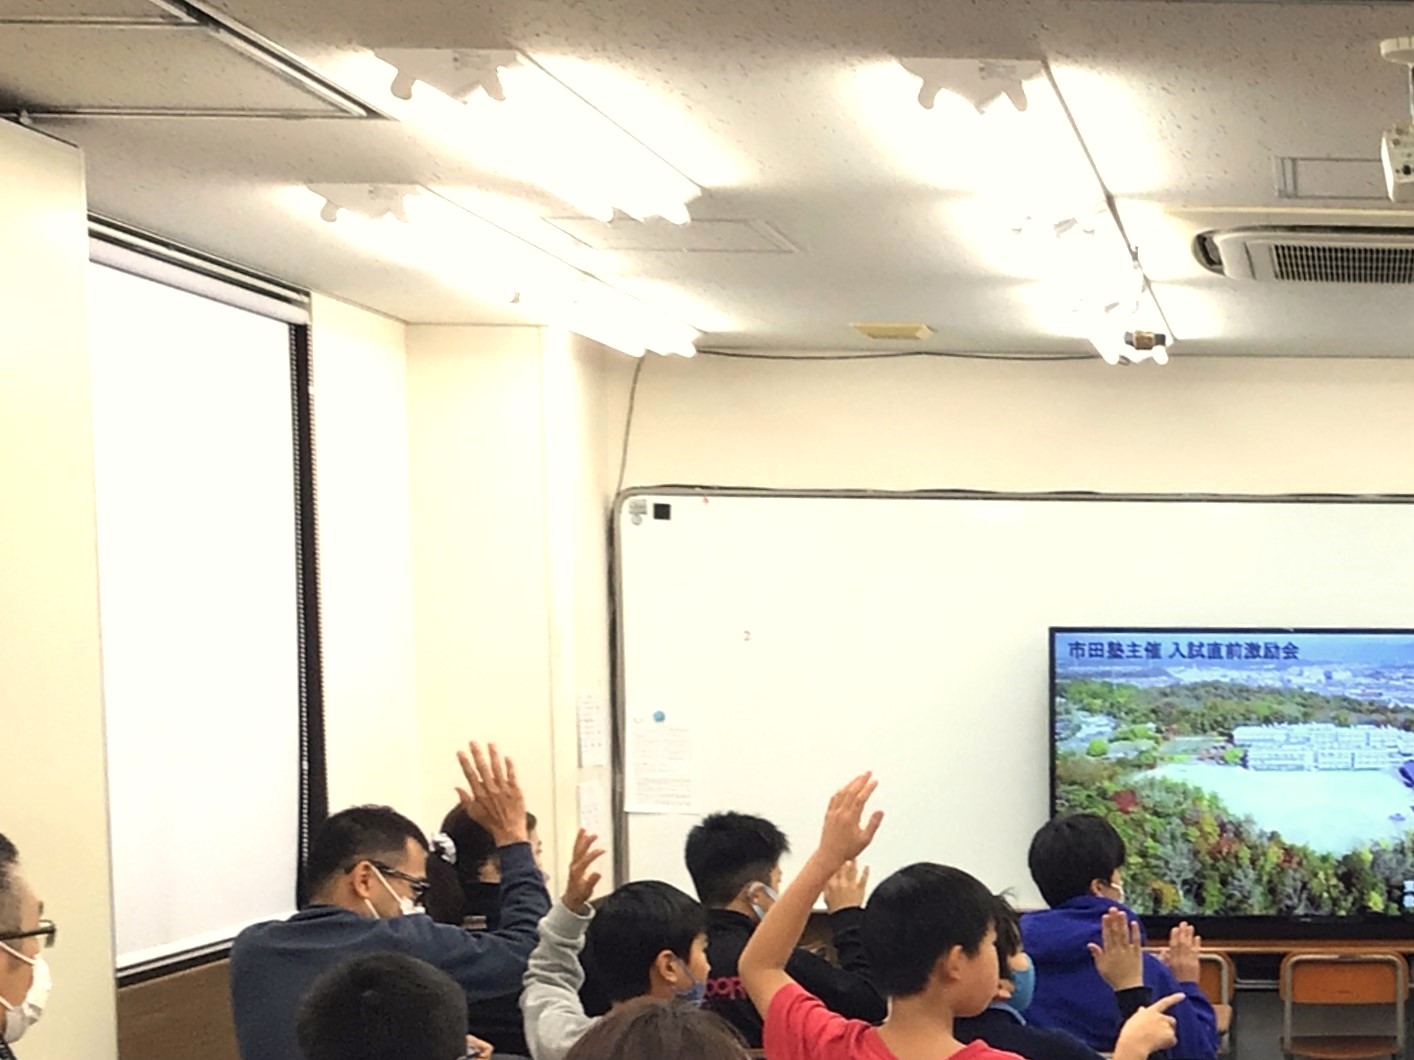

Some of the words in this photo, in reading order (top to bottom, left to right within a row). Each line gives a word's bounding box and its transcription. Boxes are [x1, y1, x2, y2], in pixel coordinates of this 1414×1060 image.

[1068, 641, 1162, 660] 市田塾主催
[1168, 641, 1300, 660] 入試直前激励会
